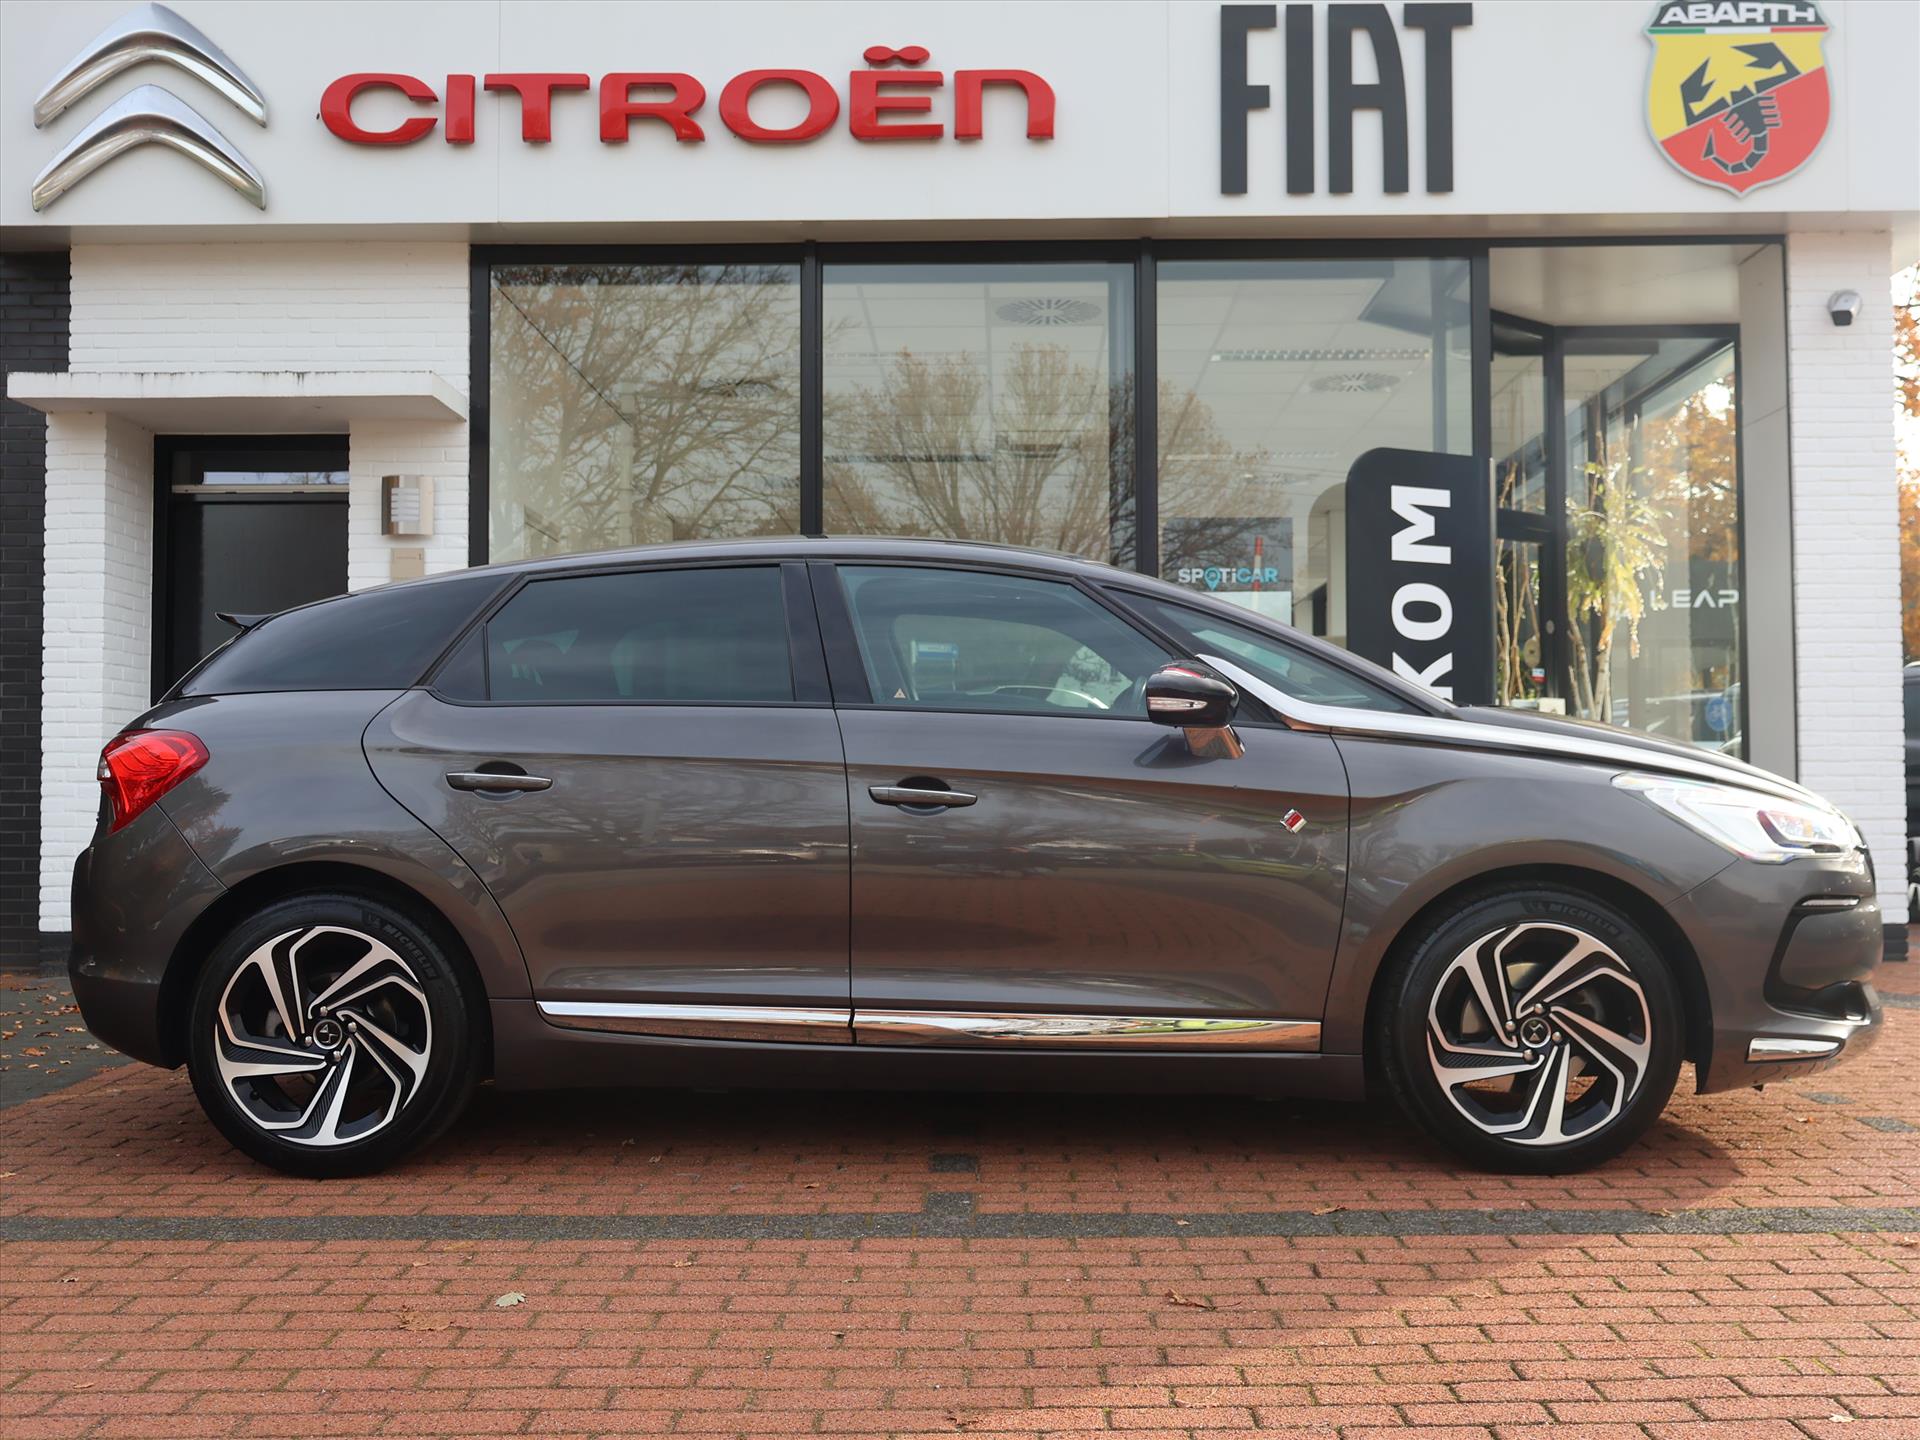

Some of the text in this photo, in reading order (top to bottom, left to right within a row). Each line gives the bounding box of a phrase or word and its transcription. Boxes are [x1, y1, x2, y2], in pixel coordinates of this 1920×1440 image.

[1660, 2, 1815, 24] ABARTH
[1220, 3, 1473, 194] FIAT
[1549, 902, 1620, 936] MICHELIN
[382, 923, 438, 978] MICHELIN
